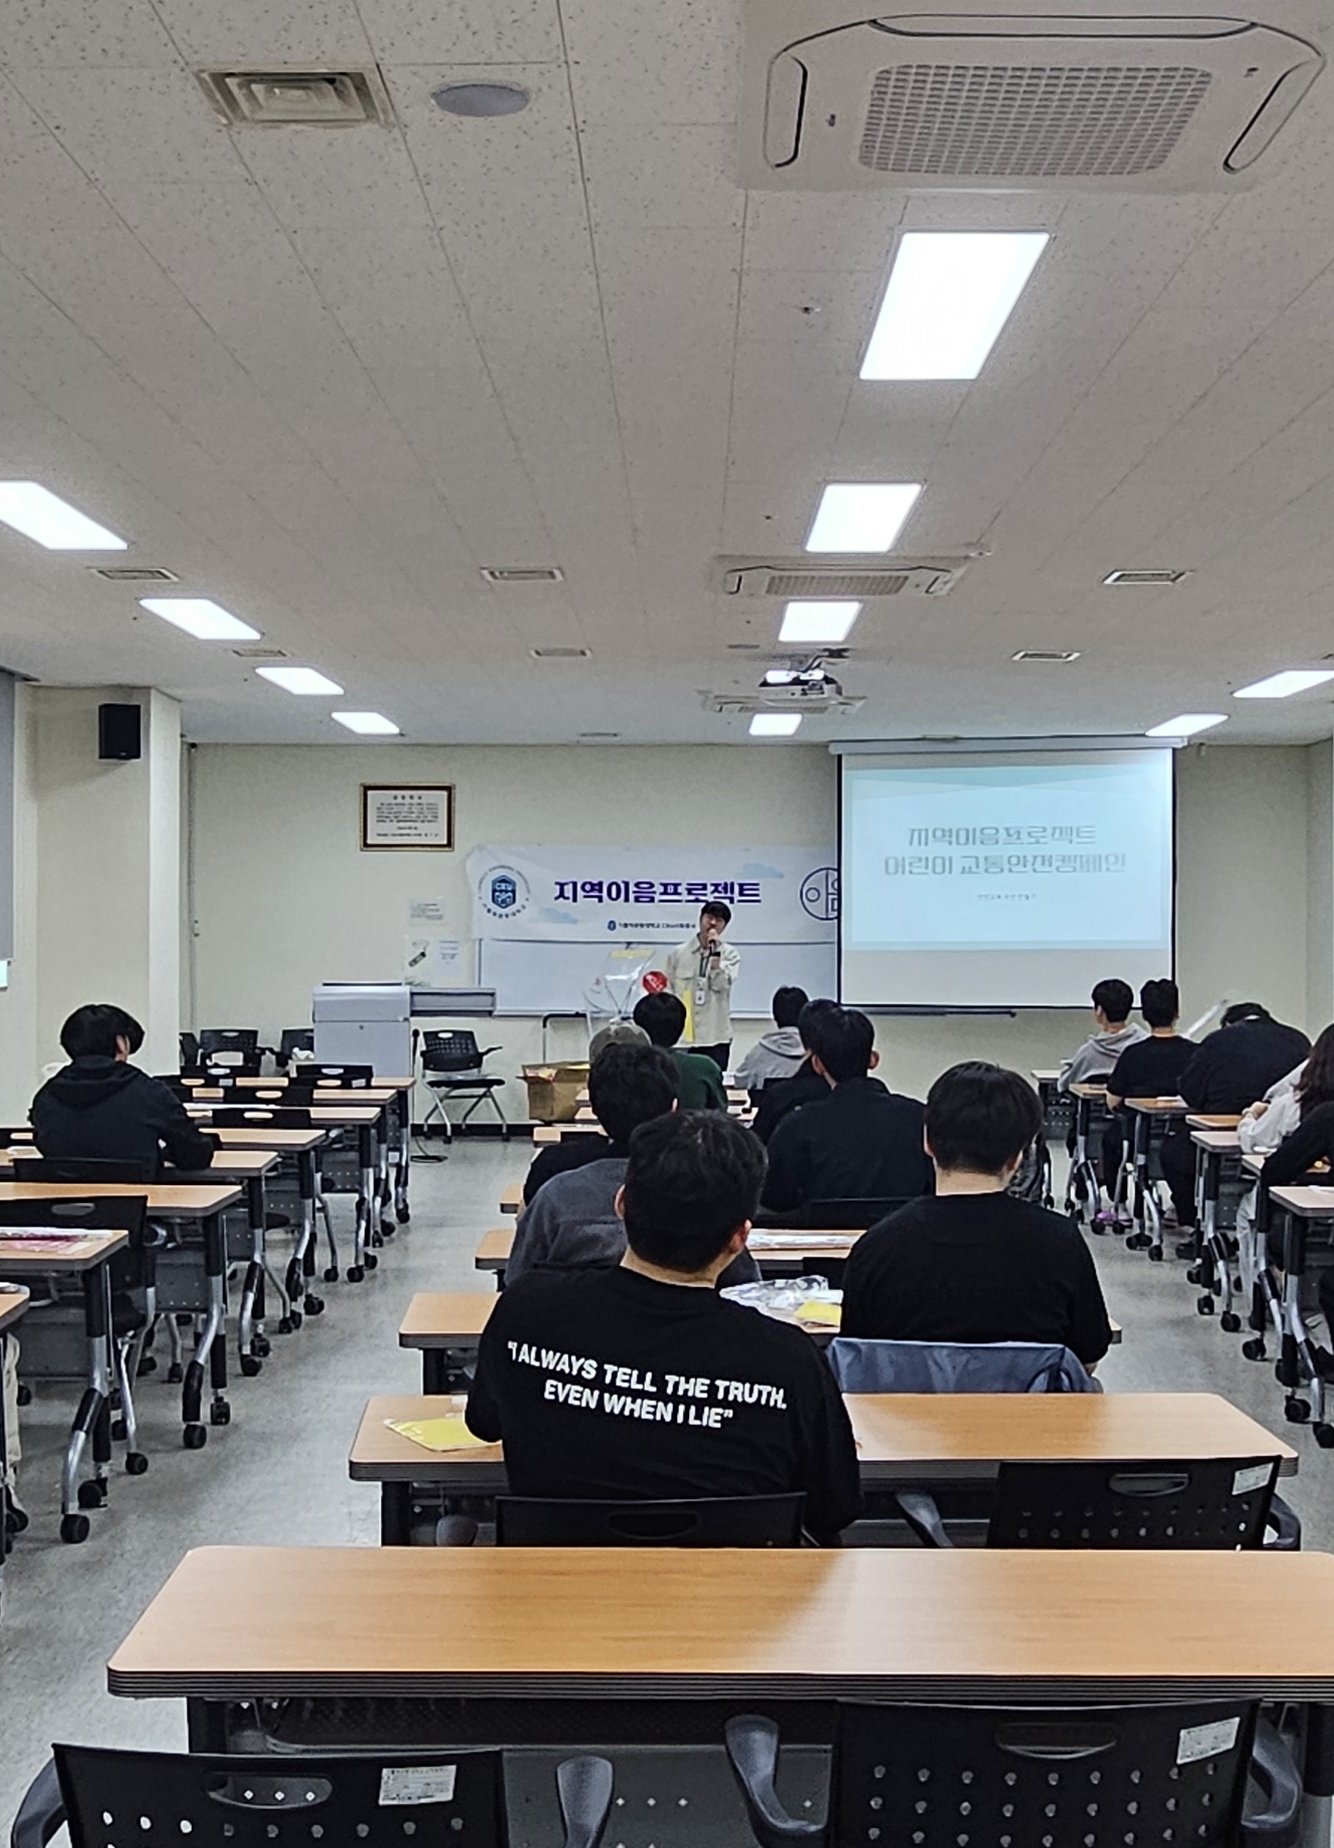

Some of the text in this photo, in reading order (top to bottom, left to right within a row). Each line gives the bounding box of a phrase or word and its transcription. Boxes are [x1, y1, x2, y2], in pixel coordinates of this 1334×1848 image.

[907, 825, 1097, 847] 지역이음프로젝트
[884, 855, 954, 876] 어린이
[553, 880, 762, 904] 지역이음프로젝트
[517, 1343, 598, 1380] ALWAYS
[603, 1363, 657, 1393] TELL
[664, 1374, 711, 1399] THE
[543, 1379, 600, 1410] EVEN
[603, 1392, 674, 1423] WHEN
[676, 1403, 686, 1424] I
